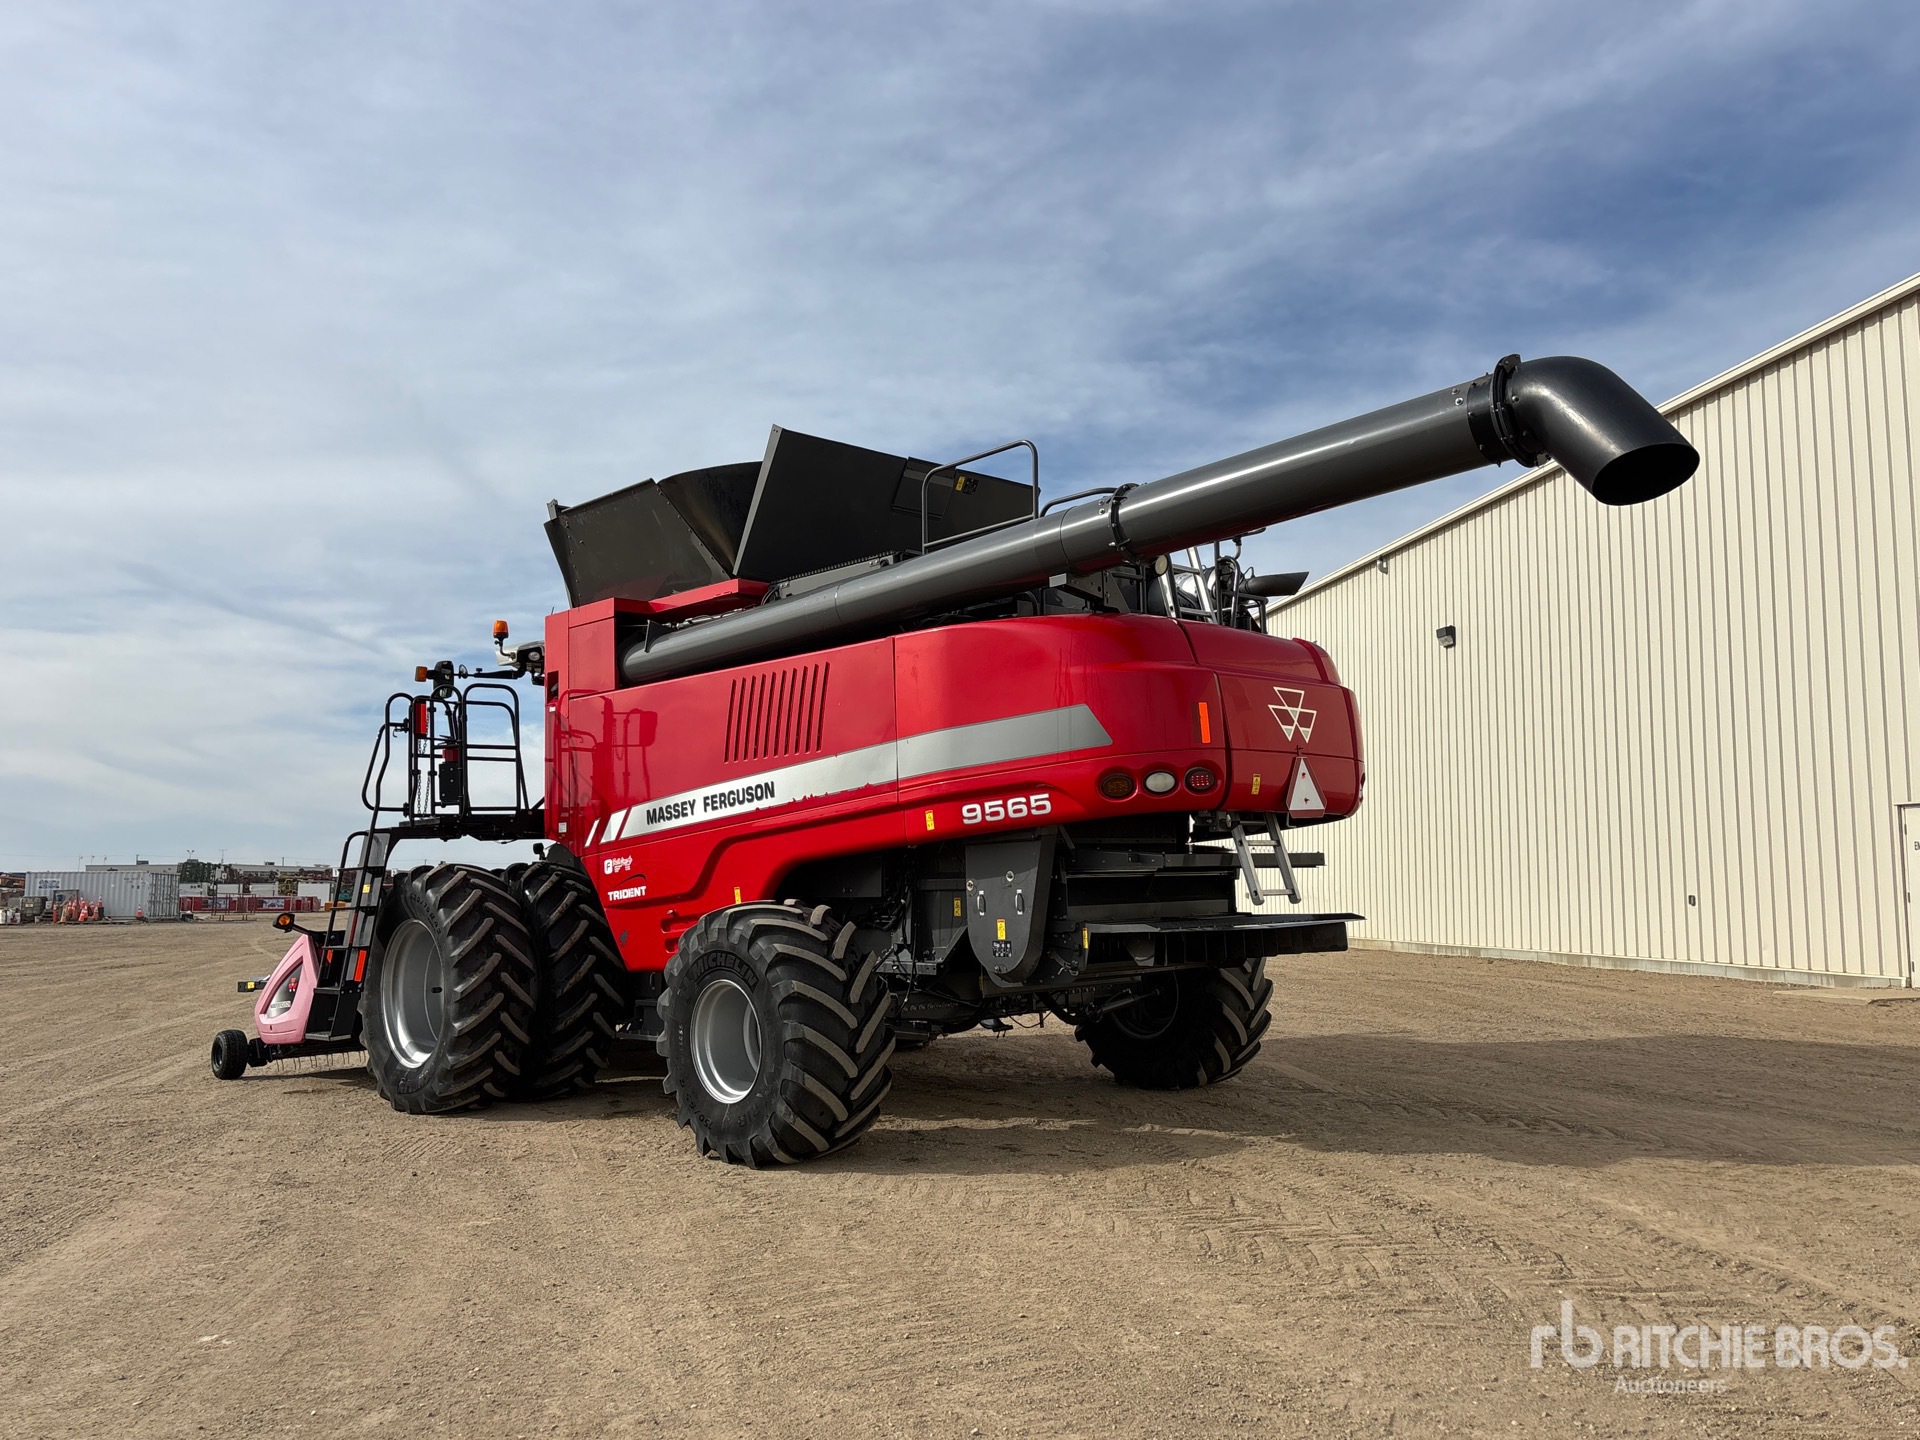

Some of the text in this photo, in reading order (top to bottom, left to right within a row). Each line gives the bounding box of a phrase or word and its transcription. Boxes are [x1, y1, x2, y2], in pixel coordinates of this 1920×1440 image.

[646, 781, 775, 825] MASSEY FERGUSON
[961, 793, 1052, 825] 9565
[607, 885, 647, 901] TRIDENT
[690, 951, 759, 987] MICHELIN
